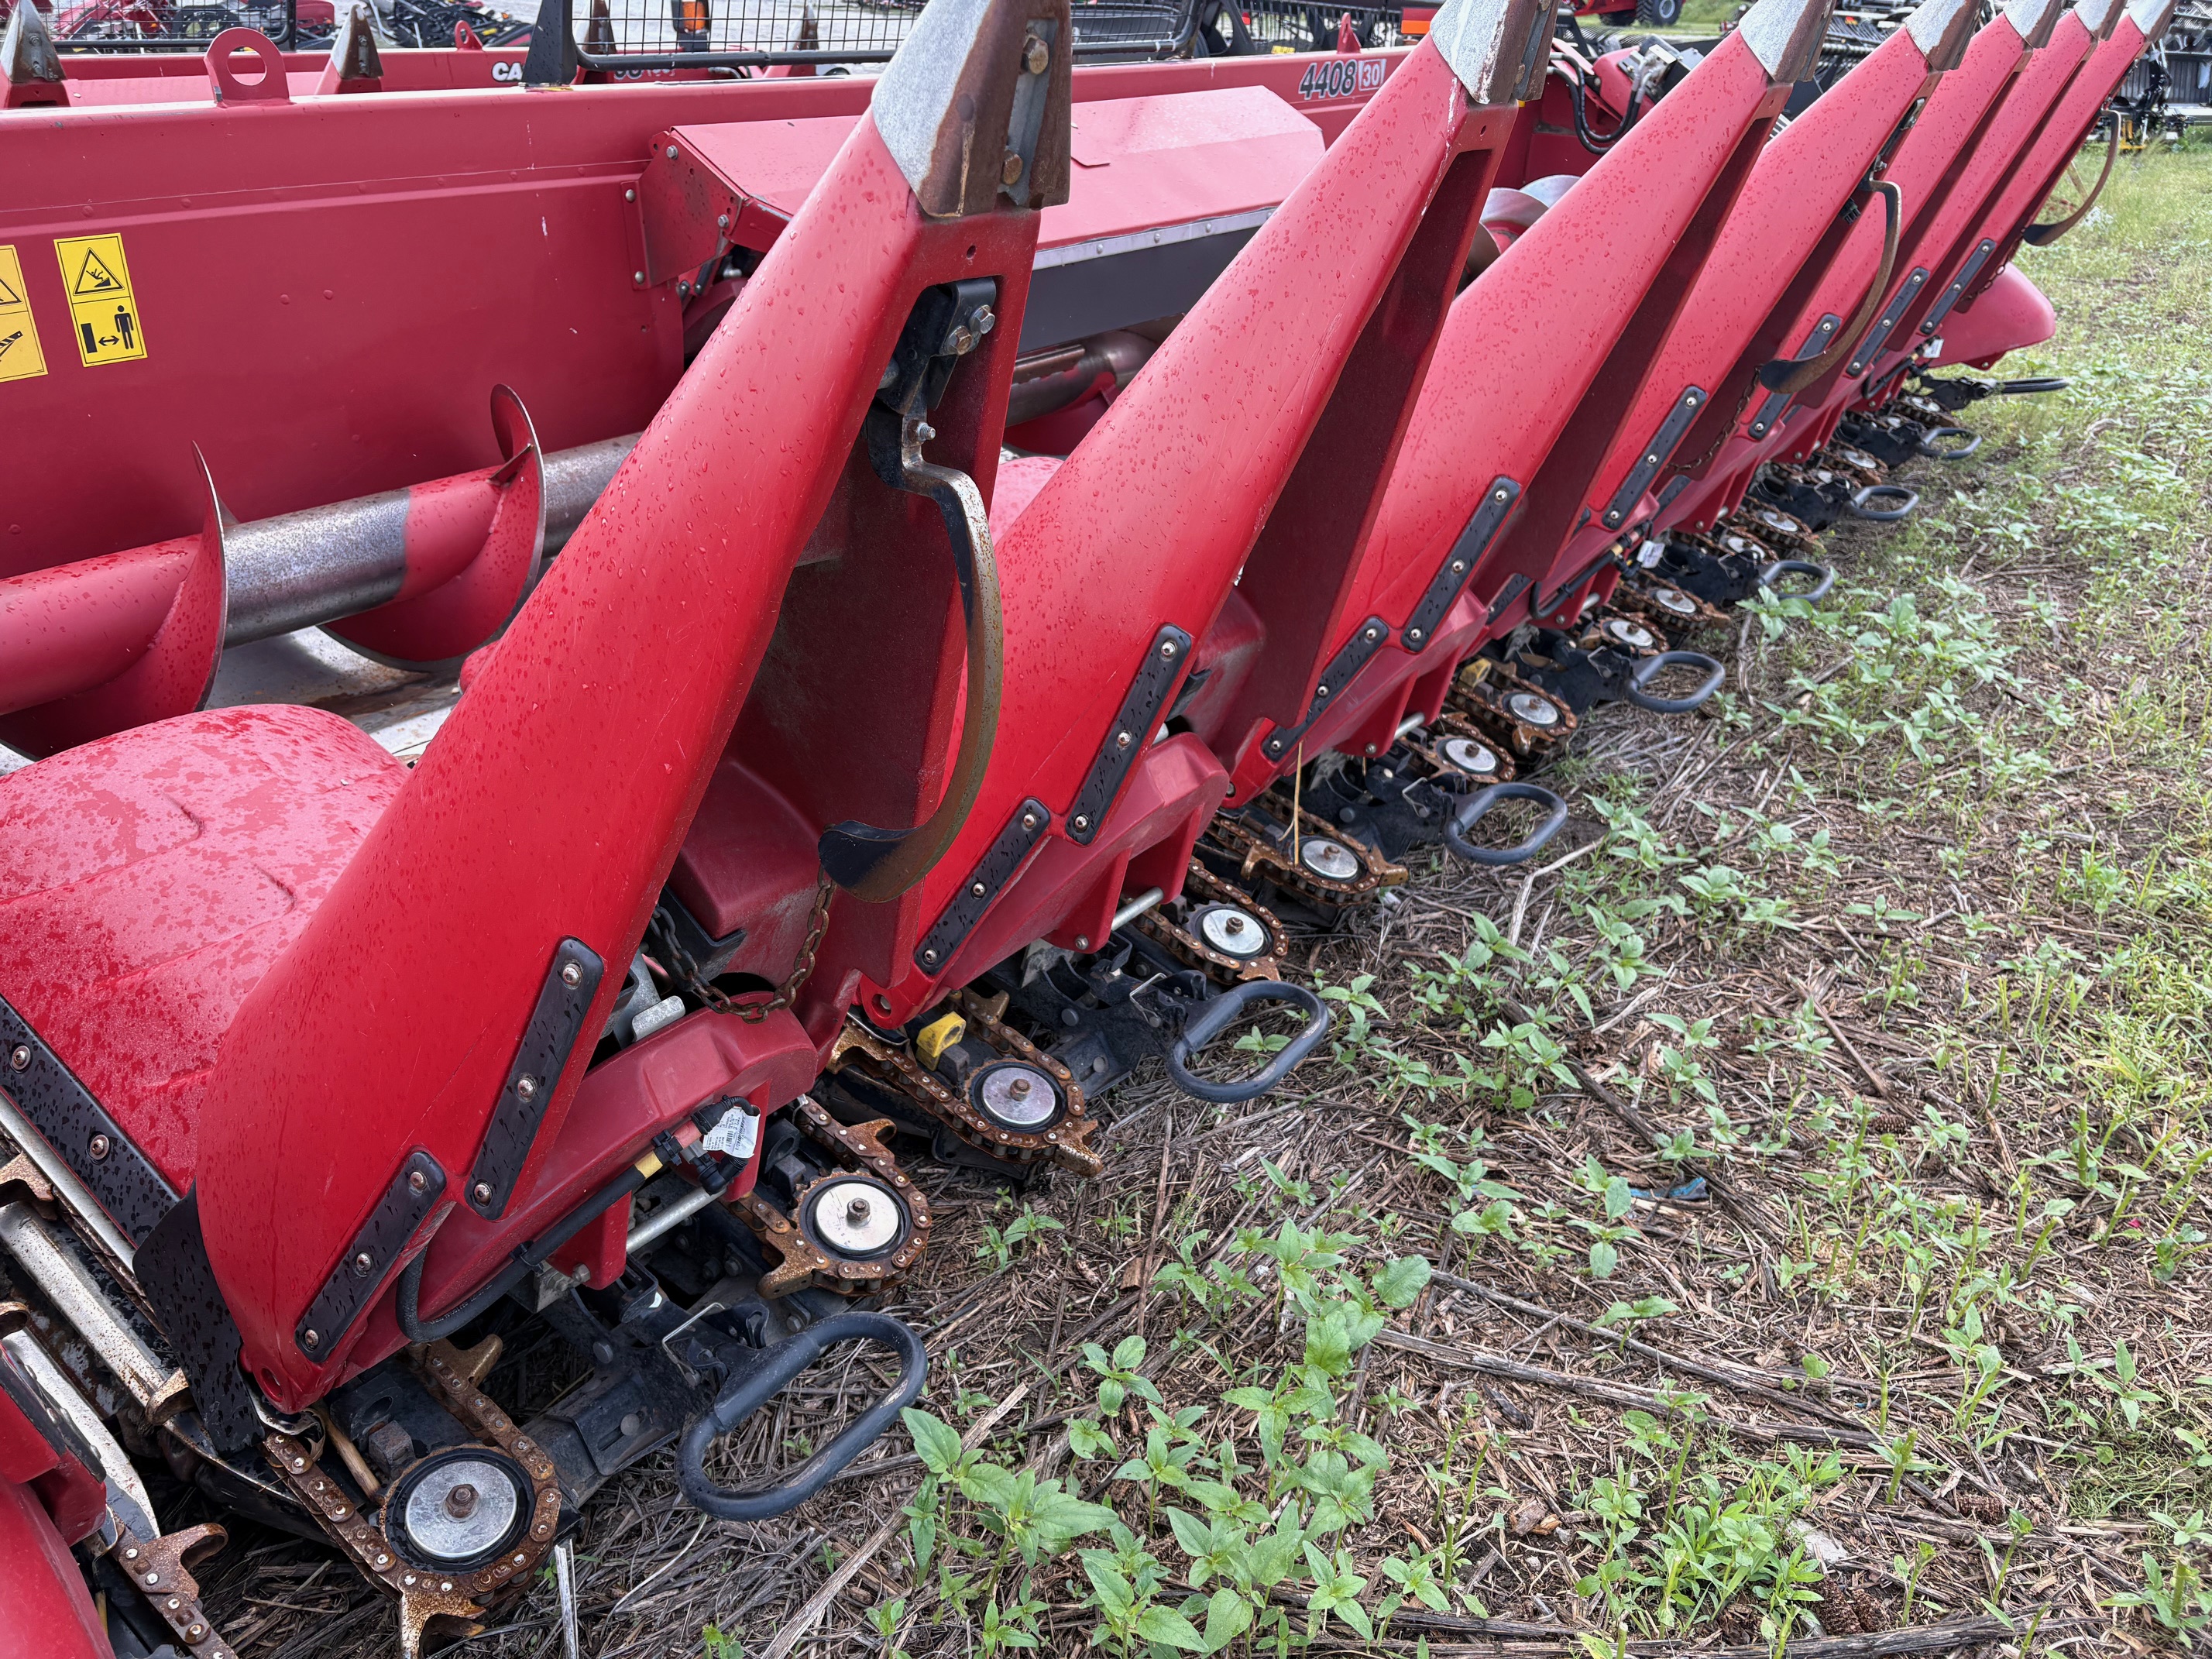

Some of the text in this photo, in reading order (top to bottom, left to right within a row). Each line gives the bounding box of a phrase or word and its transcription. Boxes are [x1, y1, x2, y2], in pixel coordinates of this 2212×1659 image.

[491, 61, 524, 82] CA
[1298, 59, 1380, 100] 4408 30
